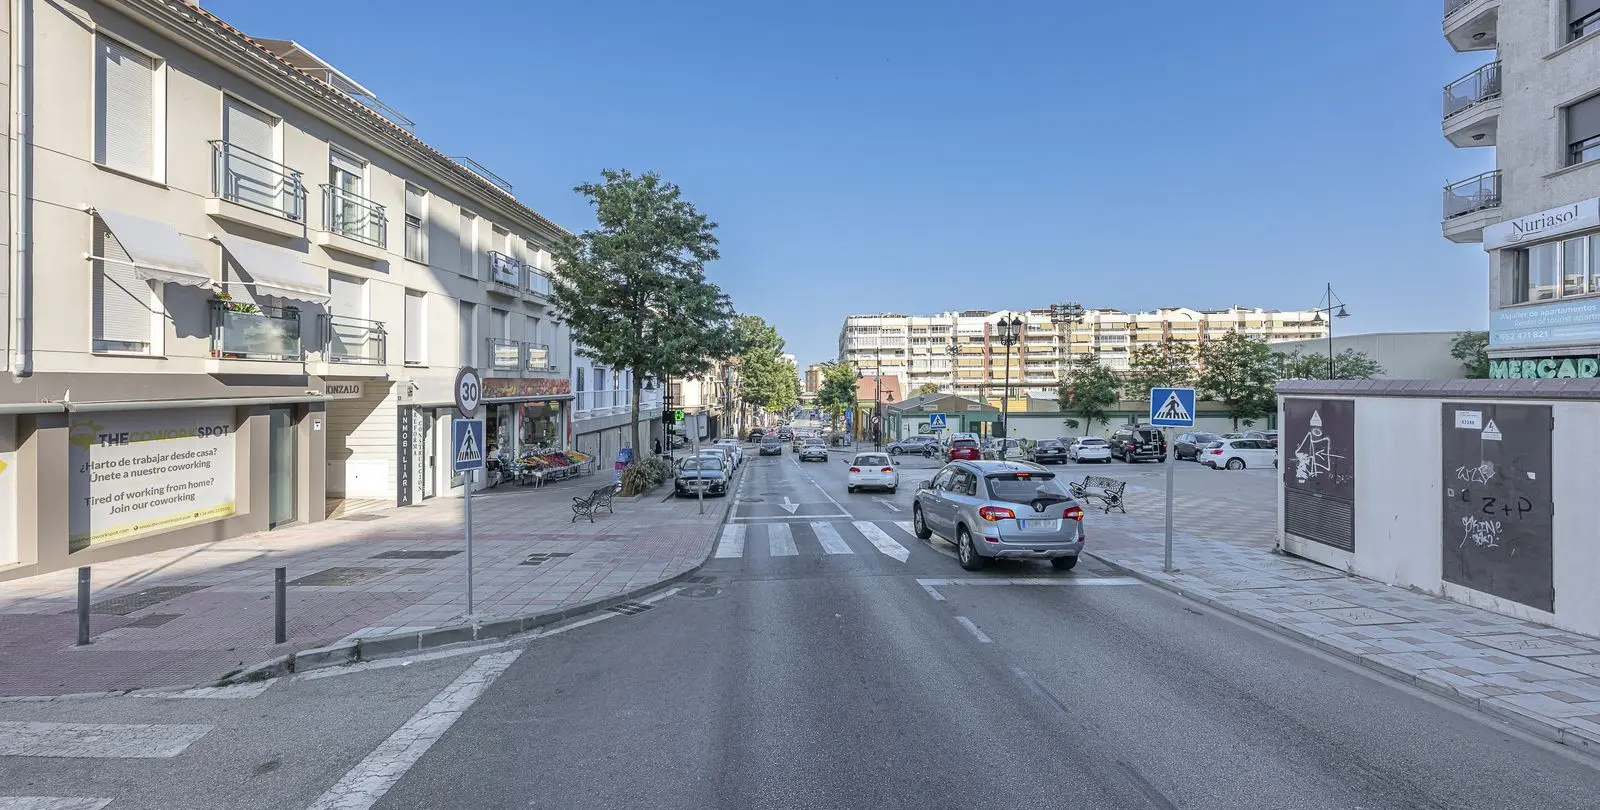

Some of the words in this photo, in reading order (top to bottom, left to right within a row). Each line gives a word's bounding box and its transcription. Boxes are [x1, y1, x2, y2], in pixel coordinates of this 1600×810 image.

[1512, 205, 1578, 235] Nuriasol
[1540, 305, 1597, 316] apartamentos
[462, 382, 477, 401] 30
[80, 460, 117, 473] ¿Harto
[118, 458, 131, 466] de
[132, 453, 169, 466] trabajar
[170, 450, 195, 460] desde
[196, 447, 218, 457] casa?
[89, 471, 121, 482] Únete
[131, 465, 166, 478] nuestro
[167, 460, 211, 472] coworking
[84, 494, 112, 507] Tired
[114, 491, 125, 501] of
[126, 487, 165, 499] working
[166, 483, 187, 493] from
[188, 477, 214, 489] home?
[109, 503, 130, 515] Join
[132, 501, 149, 511] our
[150, 493, 196, 507] coworking
